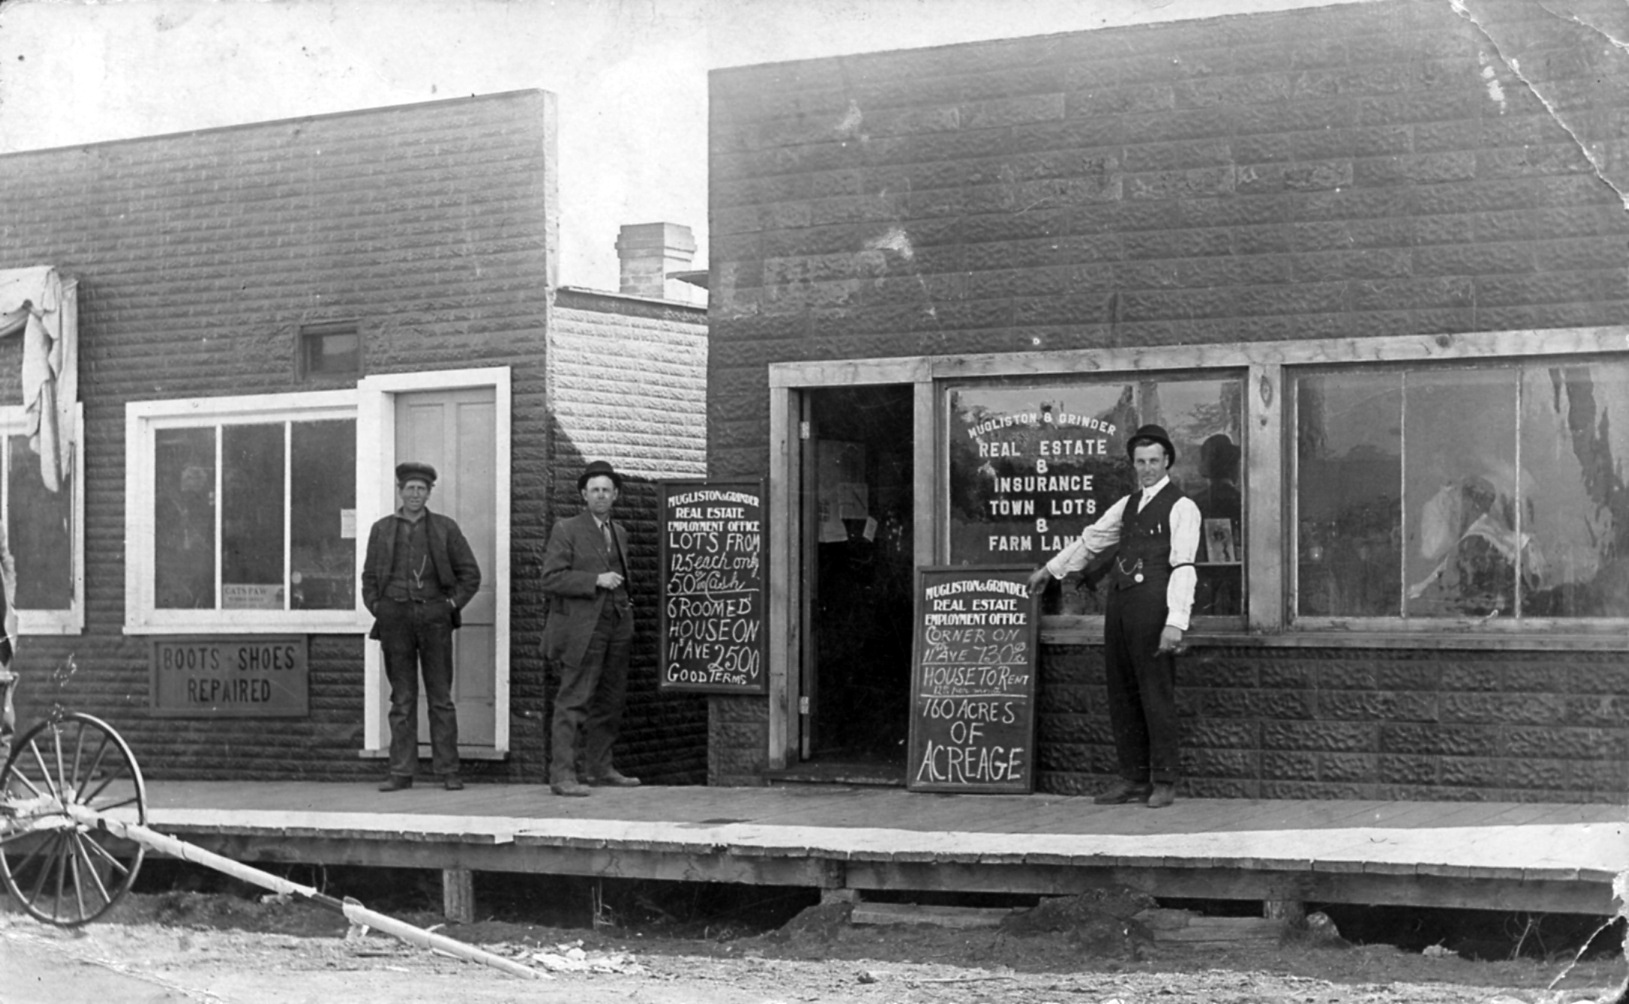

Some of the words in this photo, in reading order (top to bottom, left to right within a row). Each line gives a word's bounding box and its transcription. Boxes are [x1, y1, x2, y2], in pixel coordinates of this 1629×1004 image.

[967, 413, 1037, 439] MUGLISTON
[1059, 413, 1117, 436] GRINDER
[979, 442, 1021, 457] REAL
[1040, 439, 1107, 456] ESTATE
[1036, 459, 1049, 474] &
[994, 475, 1093, 492] INSURANCE
[675, 507, 703, 519] REAL
[707, 507, 745, 519] ESTATE
[989, 500, 1035, 516] TOWN
[1051, 499, 1097, 515] LOTS
[667, 521, 725, 532] EMPLOYMENT
[727, 521, 760, 532] OFFICE
[1036, 518, 1049, 533] &
[670, 532, 719, 553] LOTS
[726, 533, 760, 552] FROM
[988, 535, 1032, 552] FARM
[671, 553, 696, 572] 125
[694, 551, 732, 570] each
[933, 599, 967, 611] REAL
[972, 599, 1017, 611] ESTATE
[925, 613, 987, 626] EMPLOYMENT
[989, 613, 1027, 625] OFFICE
[669, 618, 731, 642] HOUSE
[732, 618, 760, 643] ON
[926, 625, 986, 644] CORNER
[992, 628, 1019, 642] ON
[163, 647, 220, 671] BOOTS
[238, 646, 296, 671] SHOES
[682, 639, 711, 660] AVE
[708, 644, 760, 679] 2500
[936, 648, 969, 663] AVE
[667, 662, 708, 683] GOOD
[708, 669, 748, 686] TERMS
[923, 666, 976, 687] HOUSE
[977, 666, 997, 686] TO
[188, 678, 271, 703] REPAIRED
[923, 698, 954, 720] 160
[957, 698, 1015, 724] ACRES
[951, 721, 984, 744] OF
[917, 739, 1024, 784] ACREAGE
